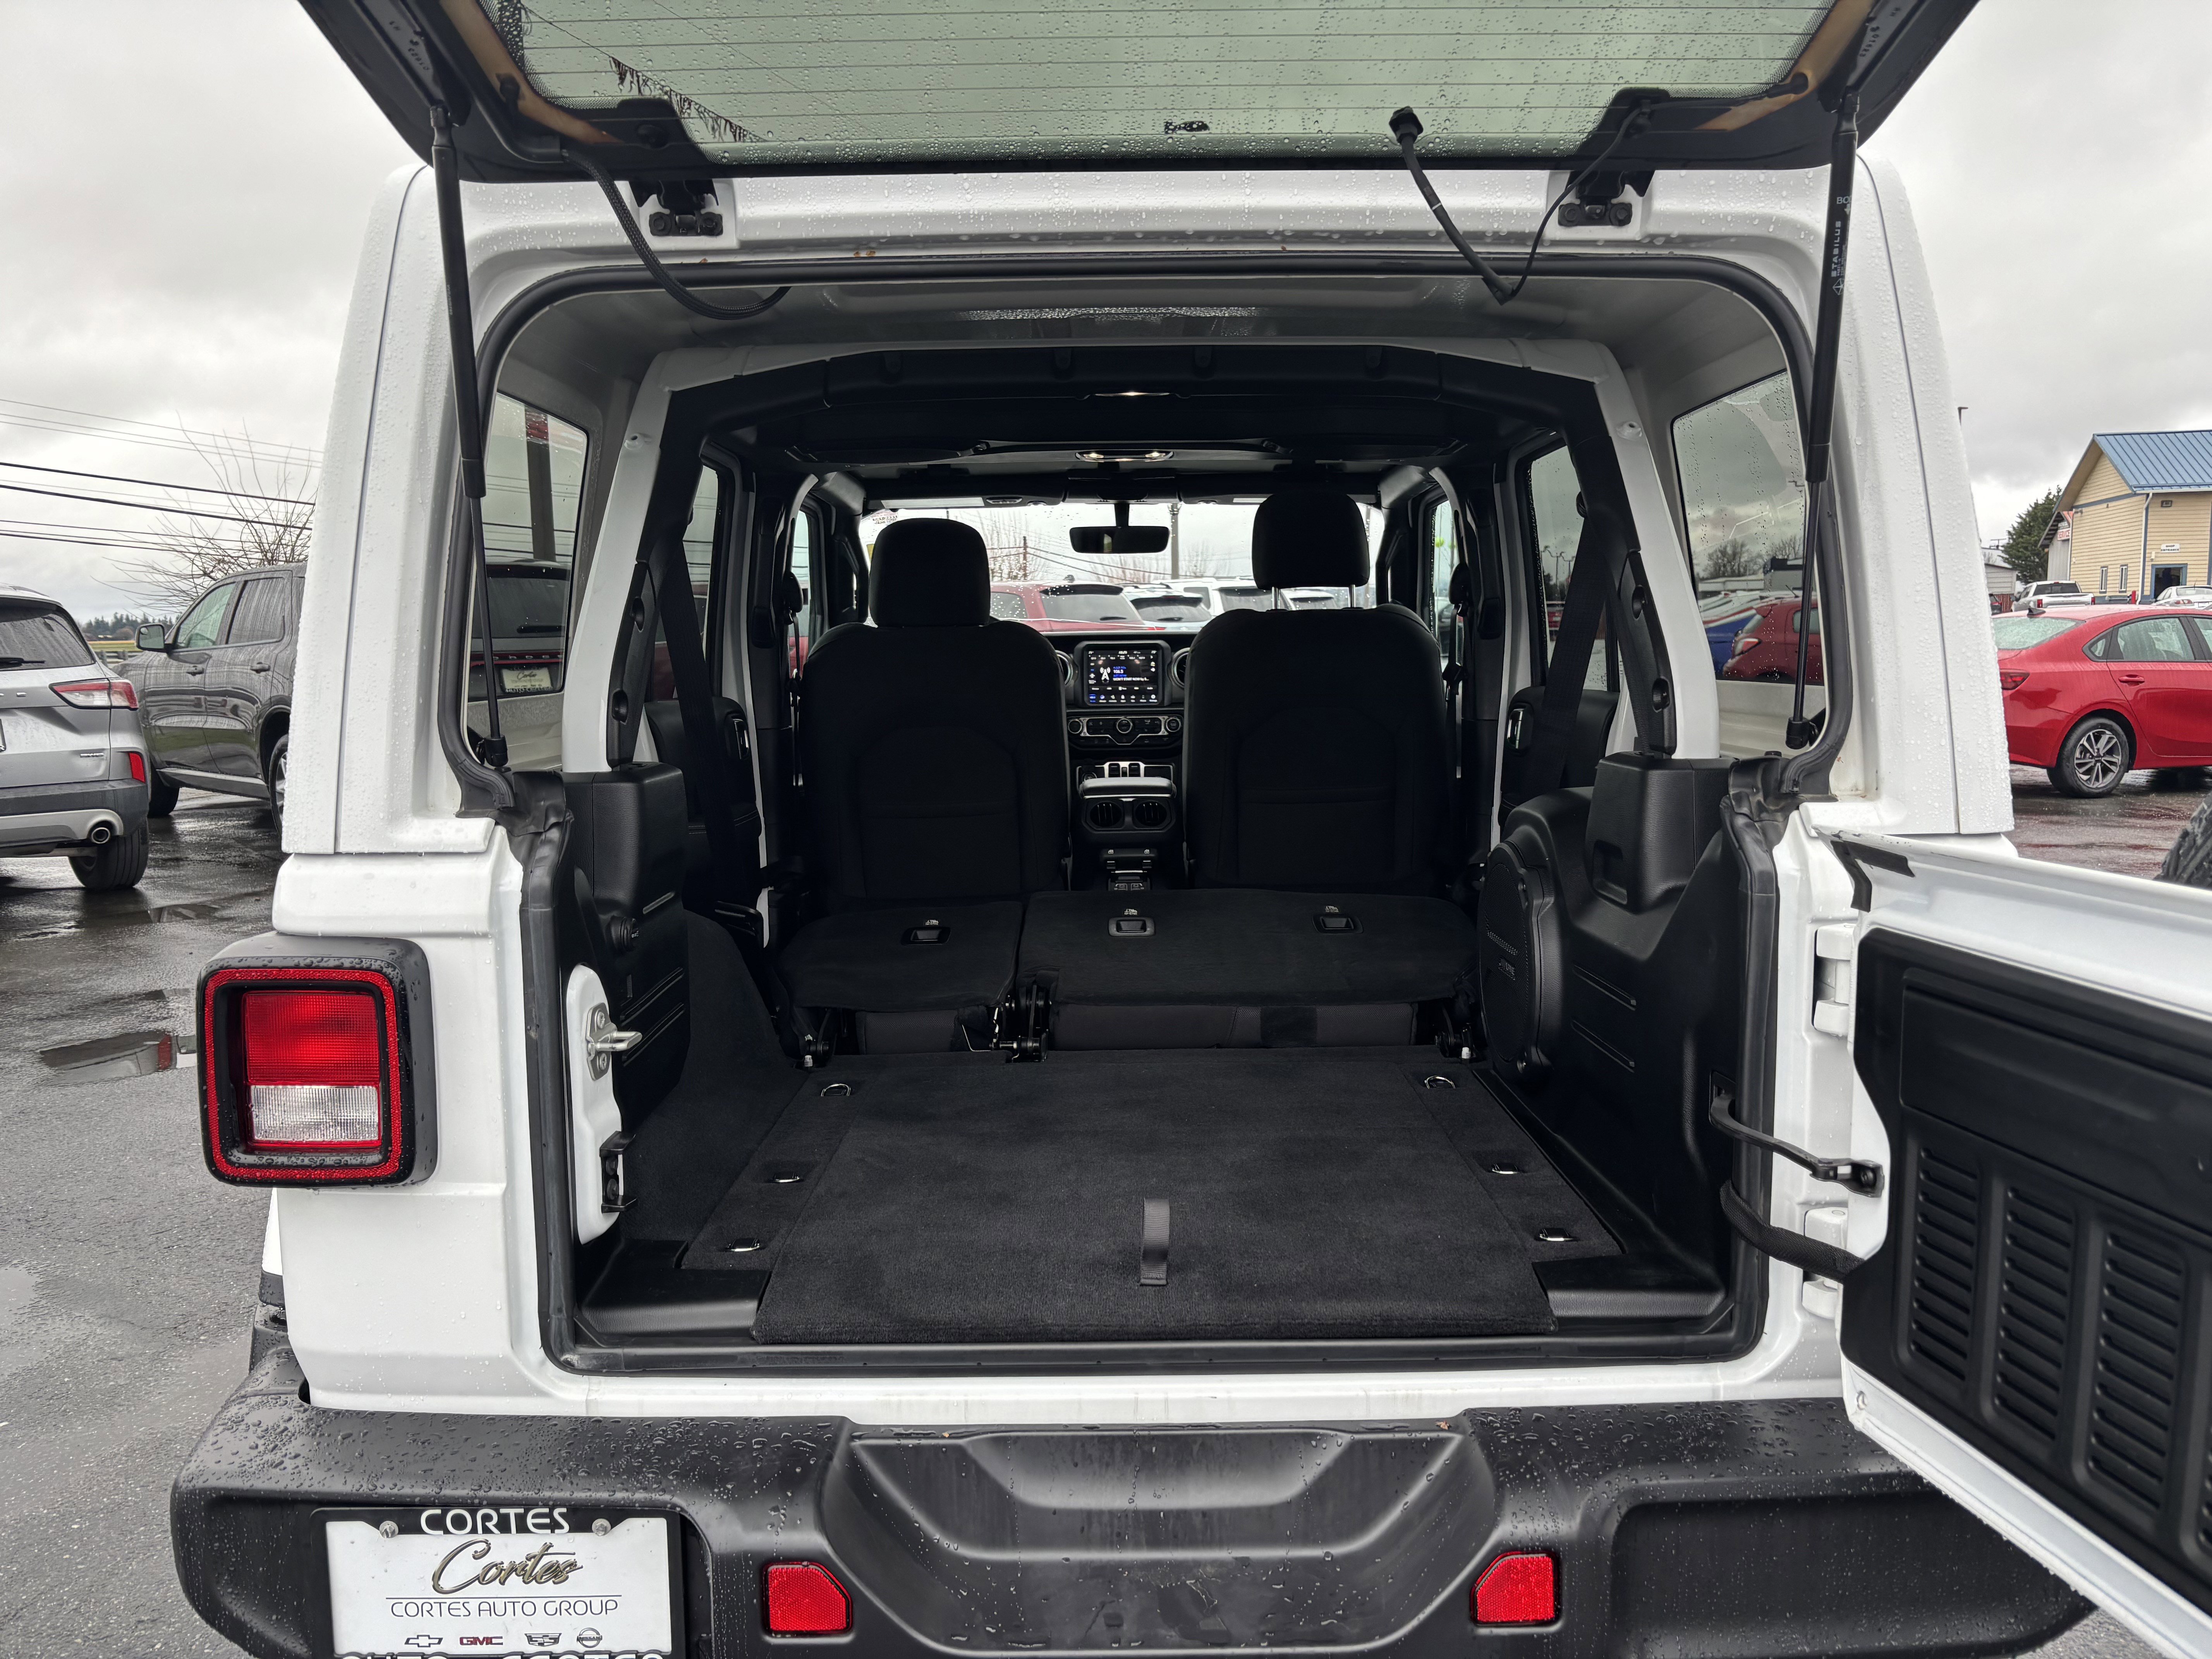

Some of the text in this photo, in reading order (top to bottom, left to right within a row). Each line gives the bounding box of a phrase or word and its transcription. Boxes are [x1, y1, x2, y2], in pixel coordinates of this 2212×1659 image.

[1831, 221, 1841, 277] STABILUS
[420, 1508, 569, 1535] CORTES
[431, 1538, 583, 1594] Cortes
[390, 1600, 618, 1618] CORTES AUTO GROUP
[459, 1636, 503, 1646] GMC
